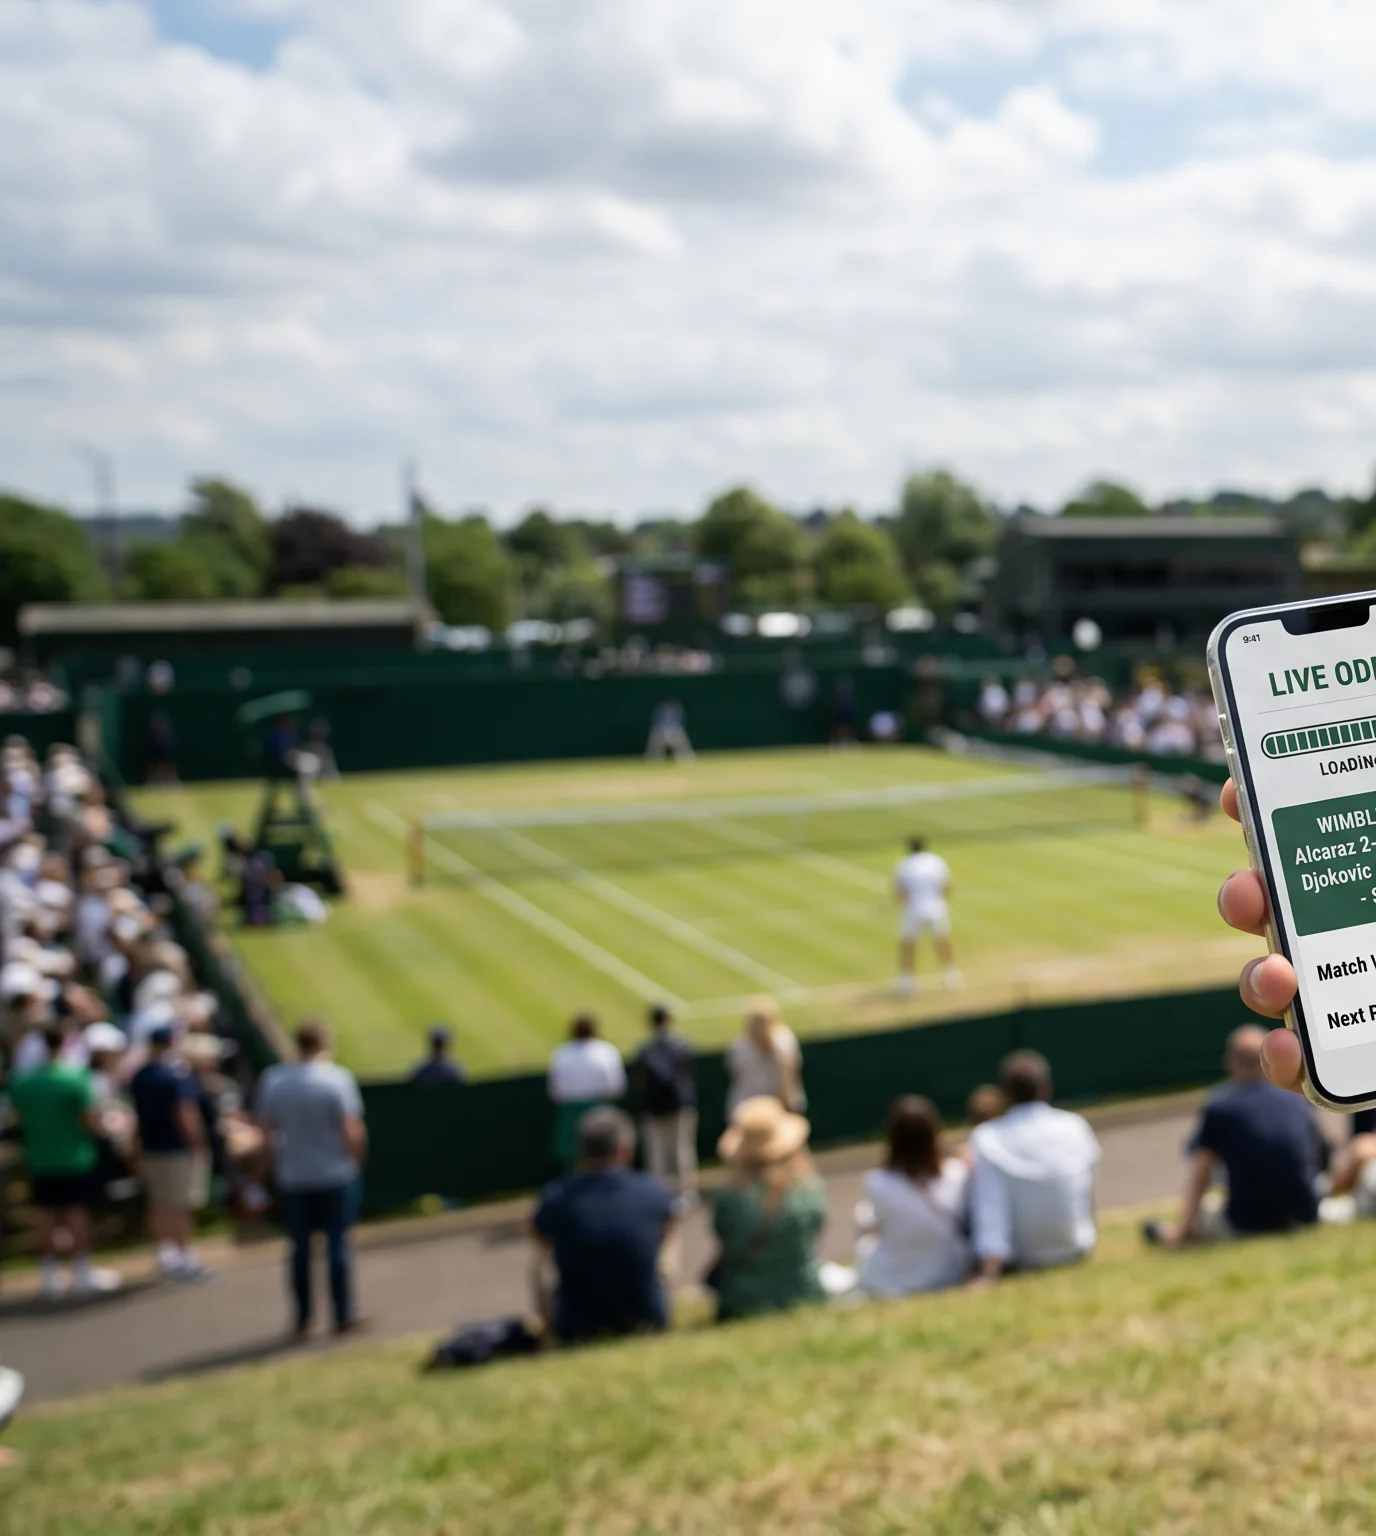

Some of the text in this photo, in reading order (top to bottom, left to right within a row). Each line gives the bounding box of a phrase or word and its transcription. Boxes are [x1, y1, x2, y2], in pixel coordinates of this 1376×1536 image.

[1243, 634, 1261, 644] 9:41
[1268, 665, 1329, 696] LIVE
[1295, 842, 1357, 865] Alcaraz
[1301, 863, 1372, 894] Djokovic
[1317, 956, 1367, 981] Match
[1327, 1008, 1366, 1029] Next
